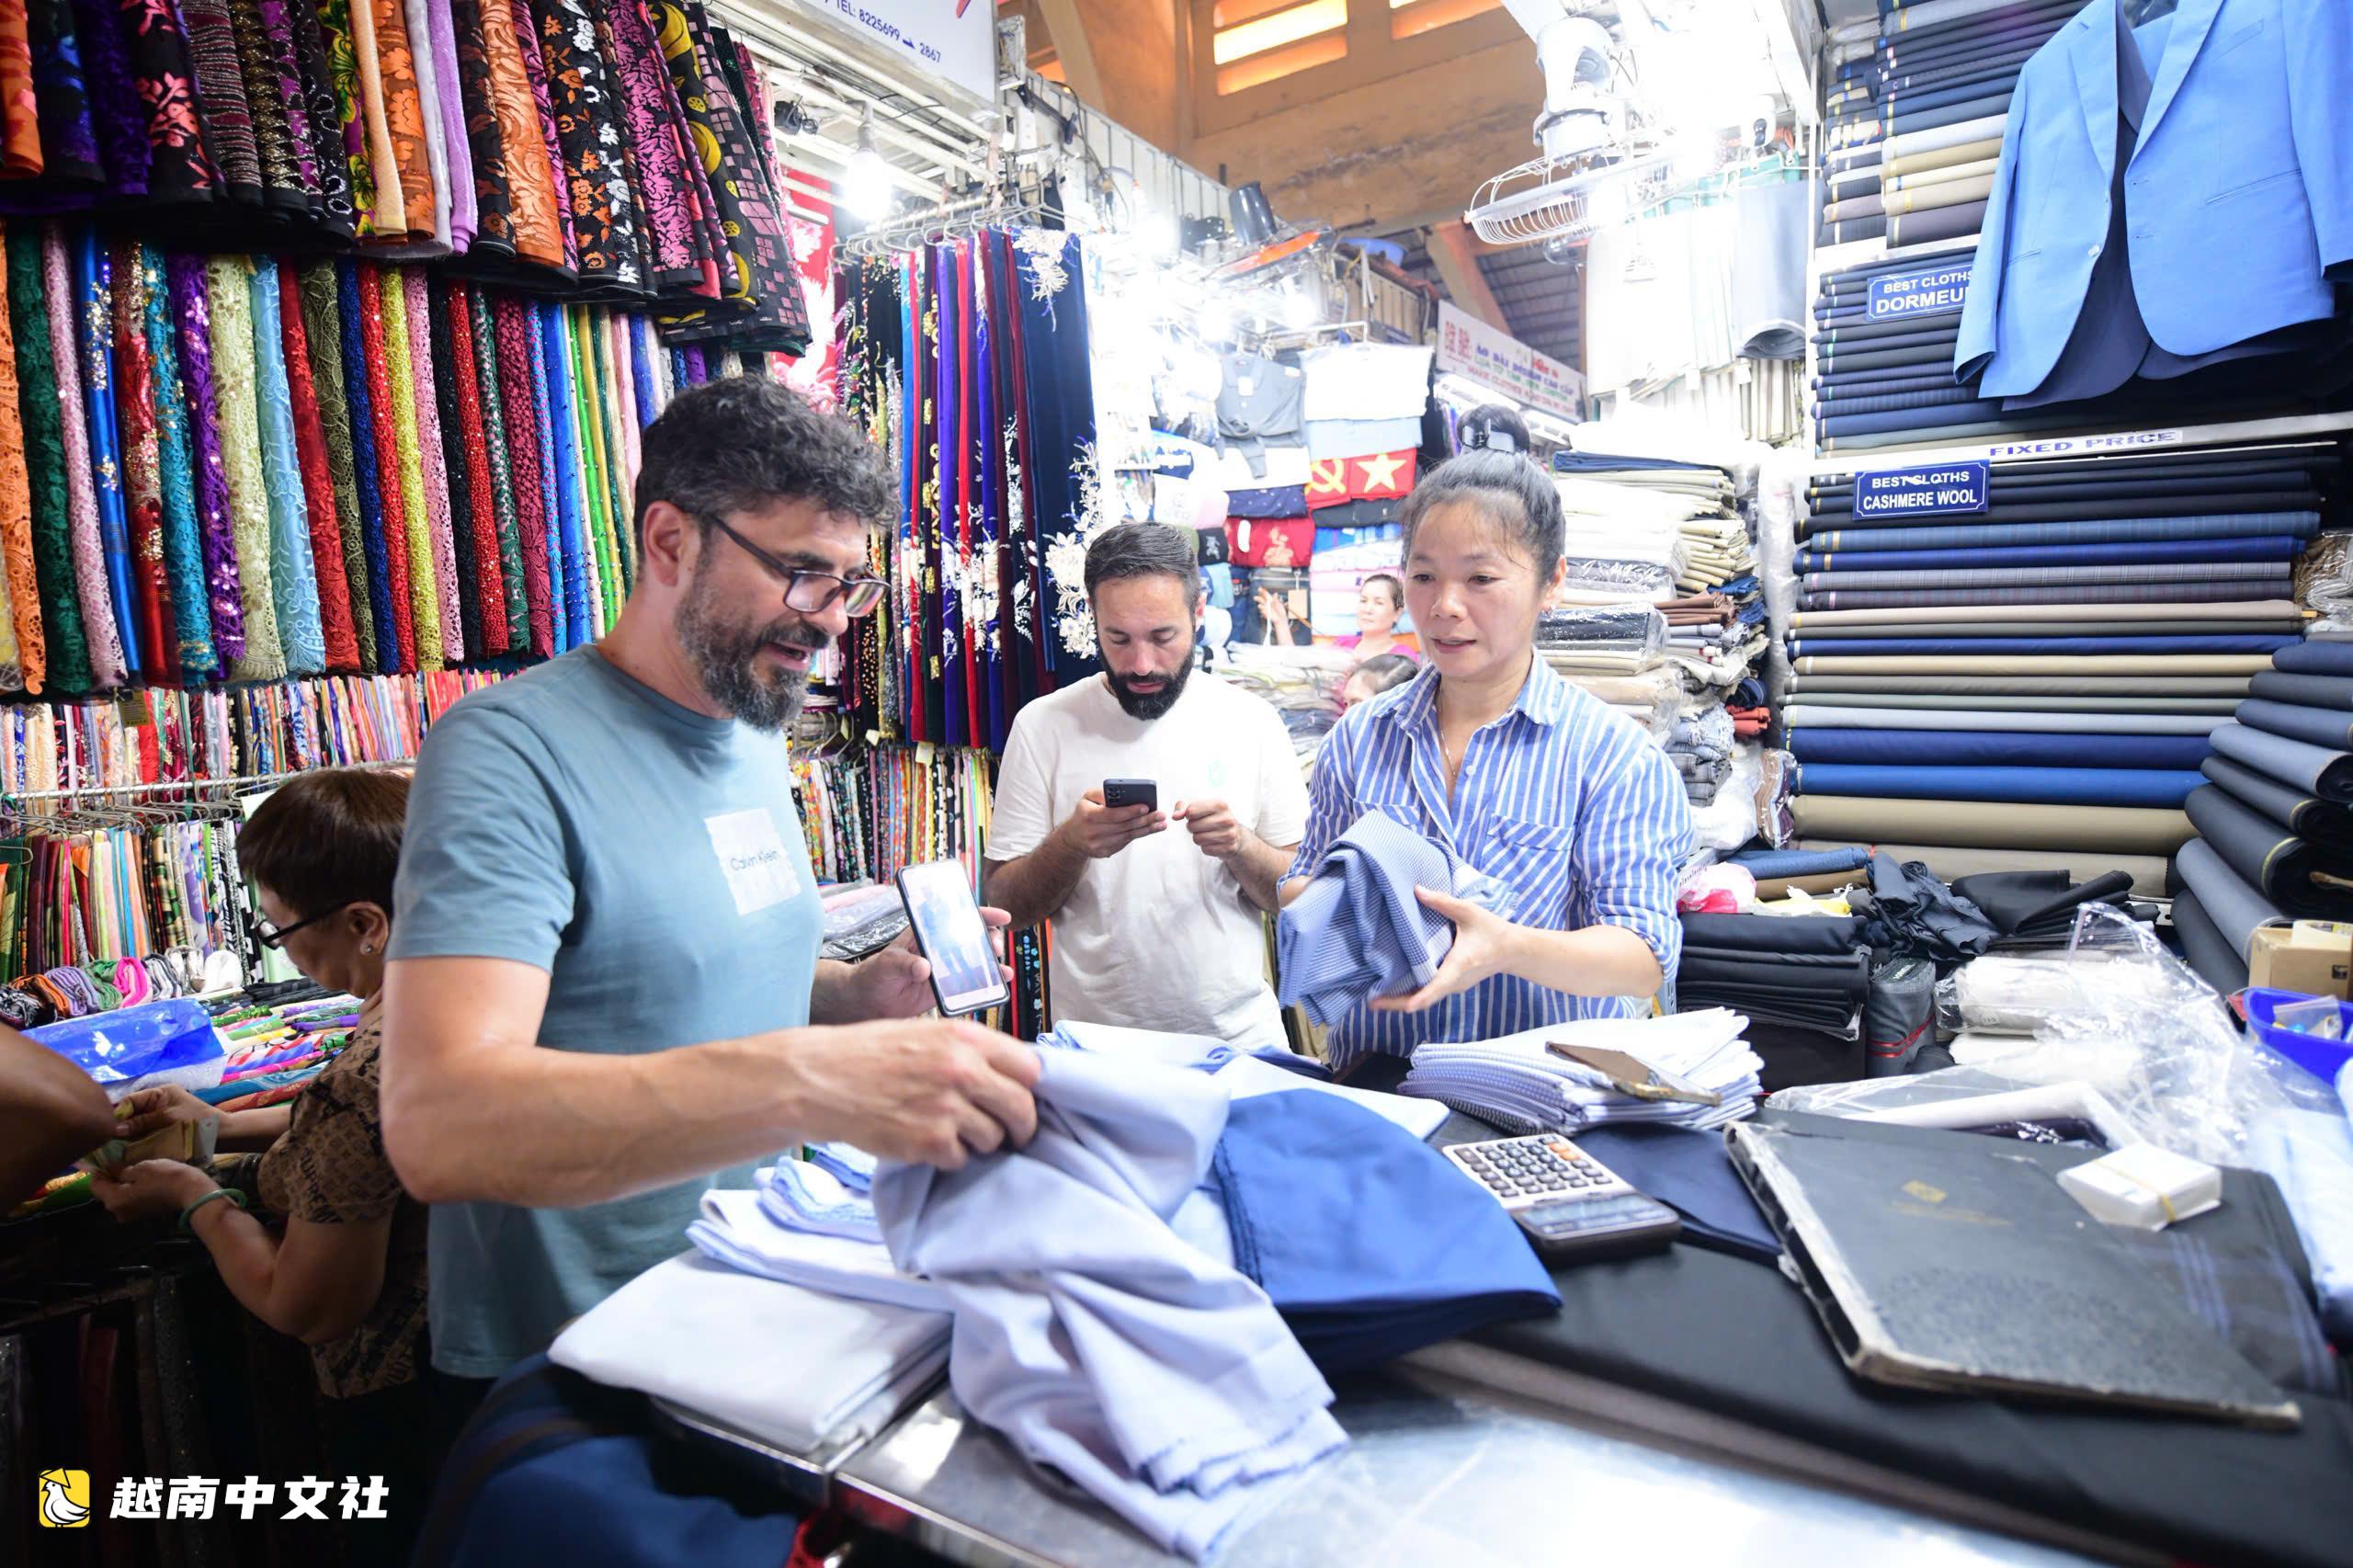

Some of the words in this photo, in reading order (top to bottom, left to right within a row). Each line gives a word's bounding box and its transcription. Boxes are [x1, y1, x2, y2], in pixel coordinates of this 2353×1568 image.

[858, 8, 901, 41] 8225699
[919, 42, 942, 62] 2867
[1883, 278, 1918, 294] BEST
[1989, 441, 2074, 457] FIXED
[2086, 431, 2177, 449] PRICE
[1871, 476, 1907, 489] BEST
[1862, 492, 1935, 510] CASHMERE
[1937, 488, 1977, 506] WOOL
